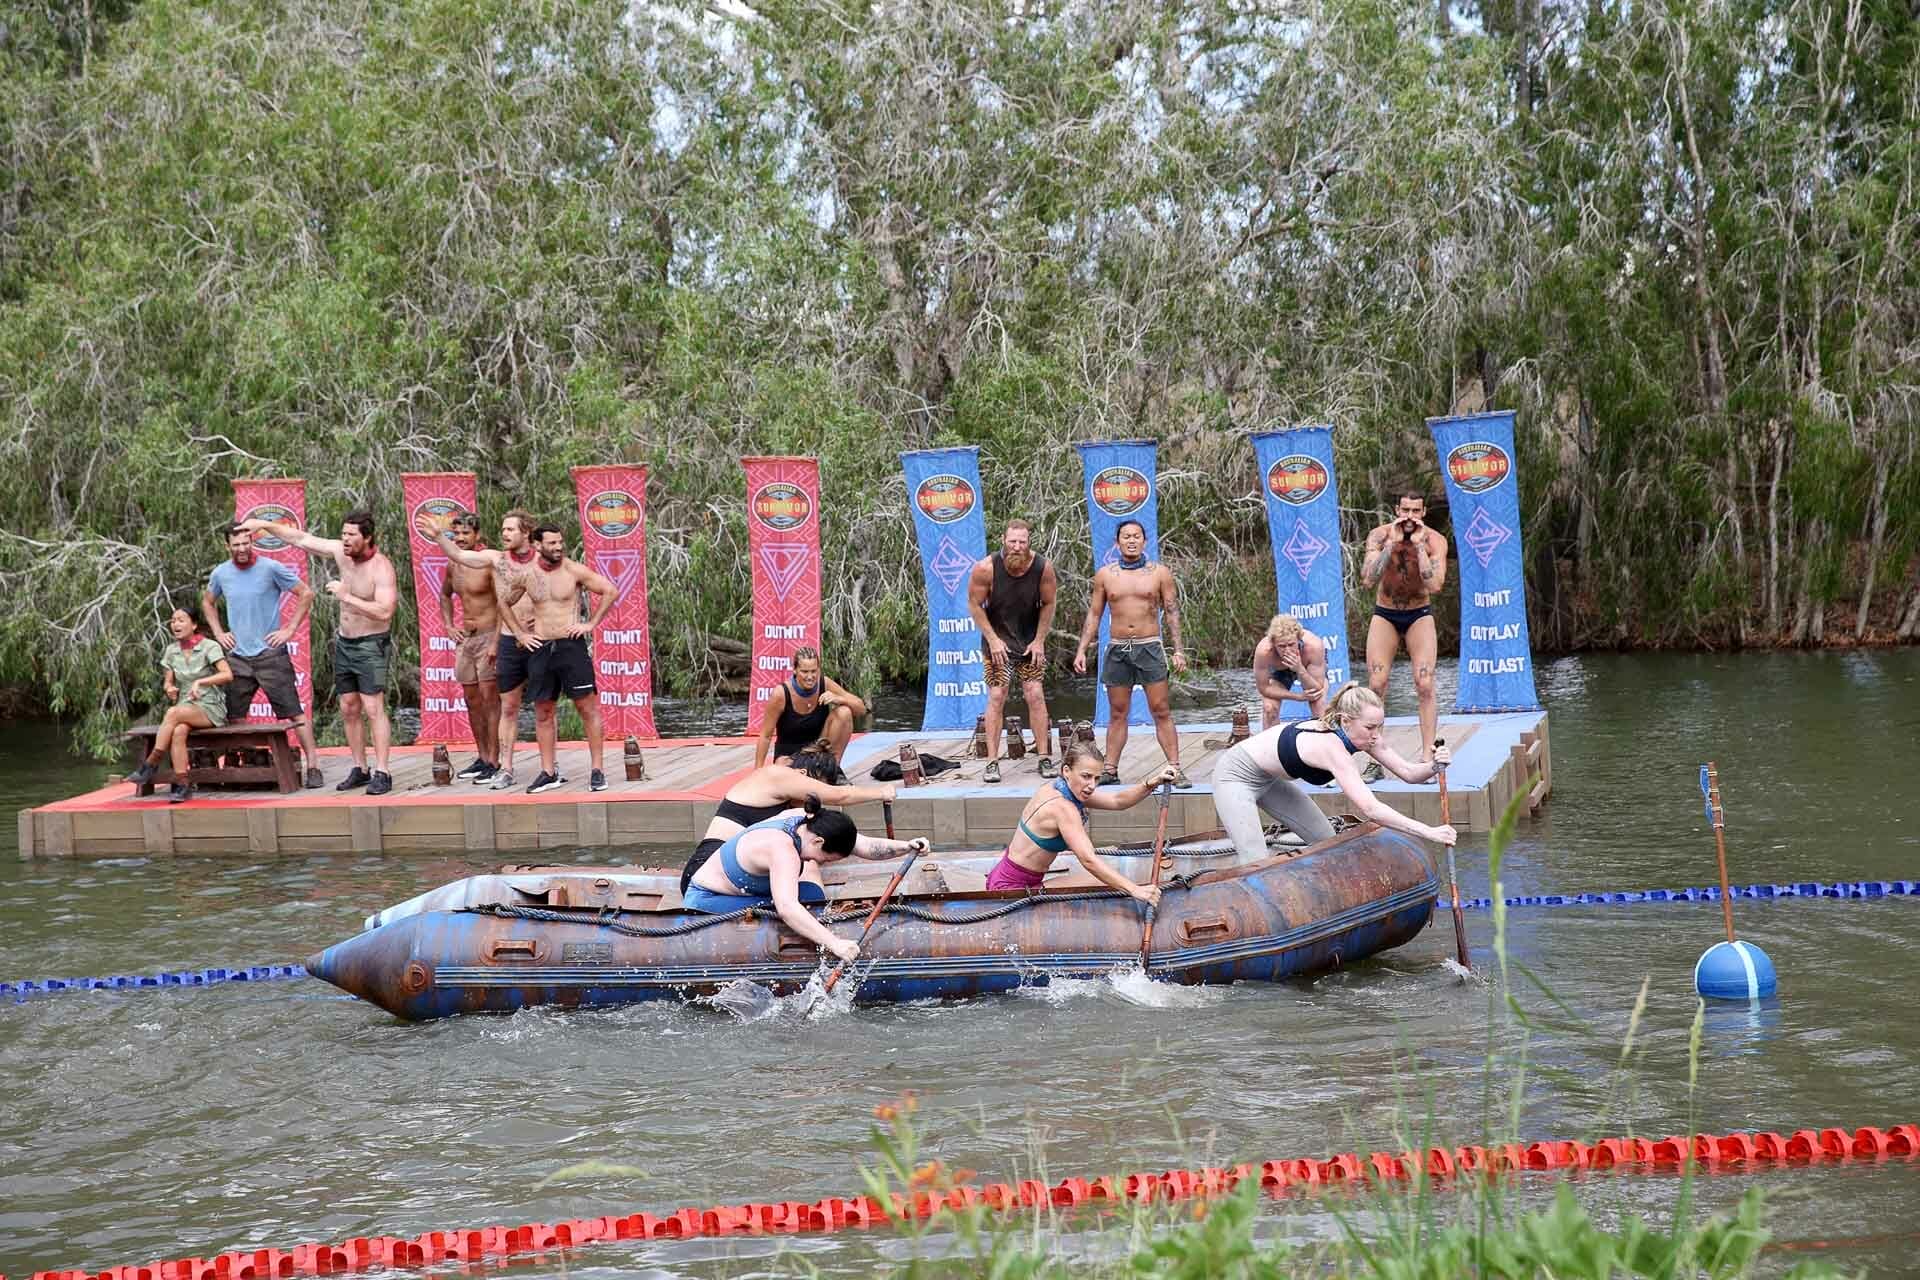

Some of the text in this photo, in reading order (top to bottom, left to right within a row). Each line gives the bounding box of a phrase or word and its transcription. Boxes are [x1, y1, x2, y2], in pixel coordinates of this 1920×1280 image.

[1474, 590, 1511, 608] OUTWIT
[1290, 602, 1329, 619] OUTWIT
[603, 629, 641, 645] OUTWIT
[764, 624, 806, 640] OUTWIT
[1470, 623, 1521, 641] OUTPLAY
[600, 660, 647, 675] OUTPLAY
[758, 655, 794, 671] OUTPL
[1468, 656, 1525, 674] OUTLAST
[425, 667, 457, 681] OUTPL
[934, 680, 987, 697] OUTLAST
[600, 691, 649, 706] OUTLAST
